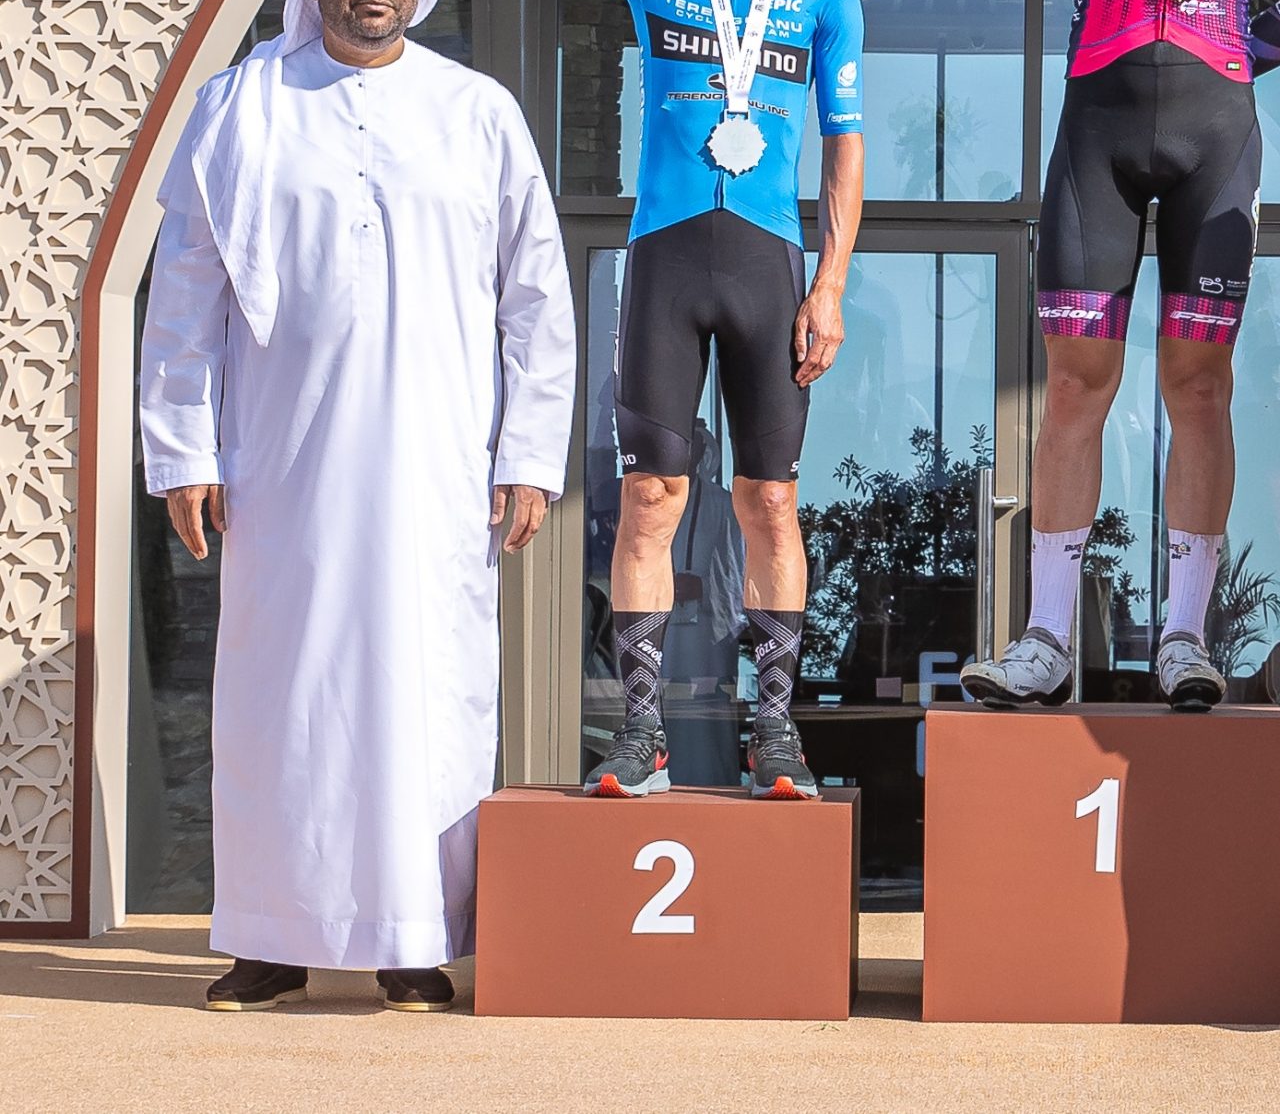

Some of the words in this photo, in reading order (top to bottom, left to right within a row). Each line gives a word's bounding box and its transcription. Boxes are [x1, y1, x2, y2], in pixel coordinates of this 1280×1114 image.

[663, 29, 798, 74] SHINO
[667, 92, 765, 110] TERENGNU
[767, 105, 791, 117] INC
[1075, 778, 1120, 873] 1
[632, 839, 695, 934] 2
